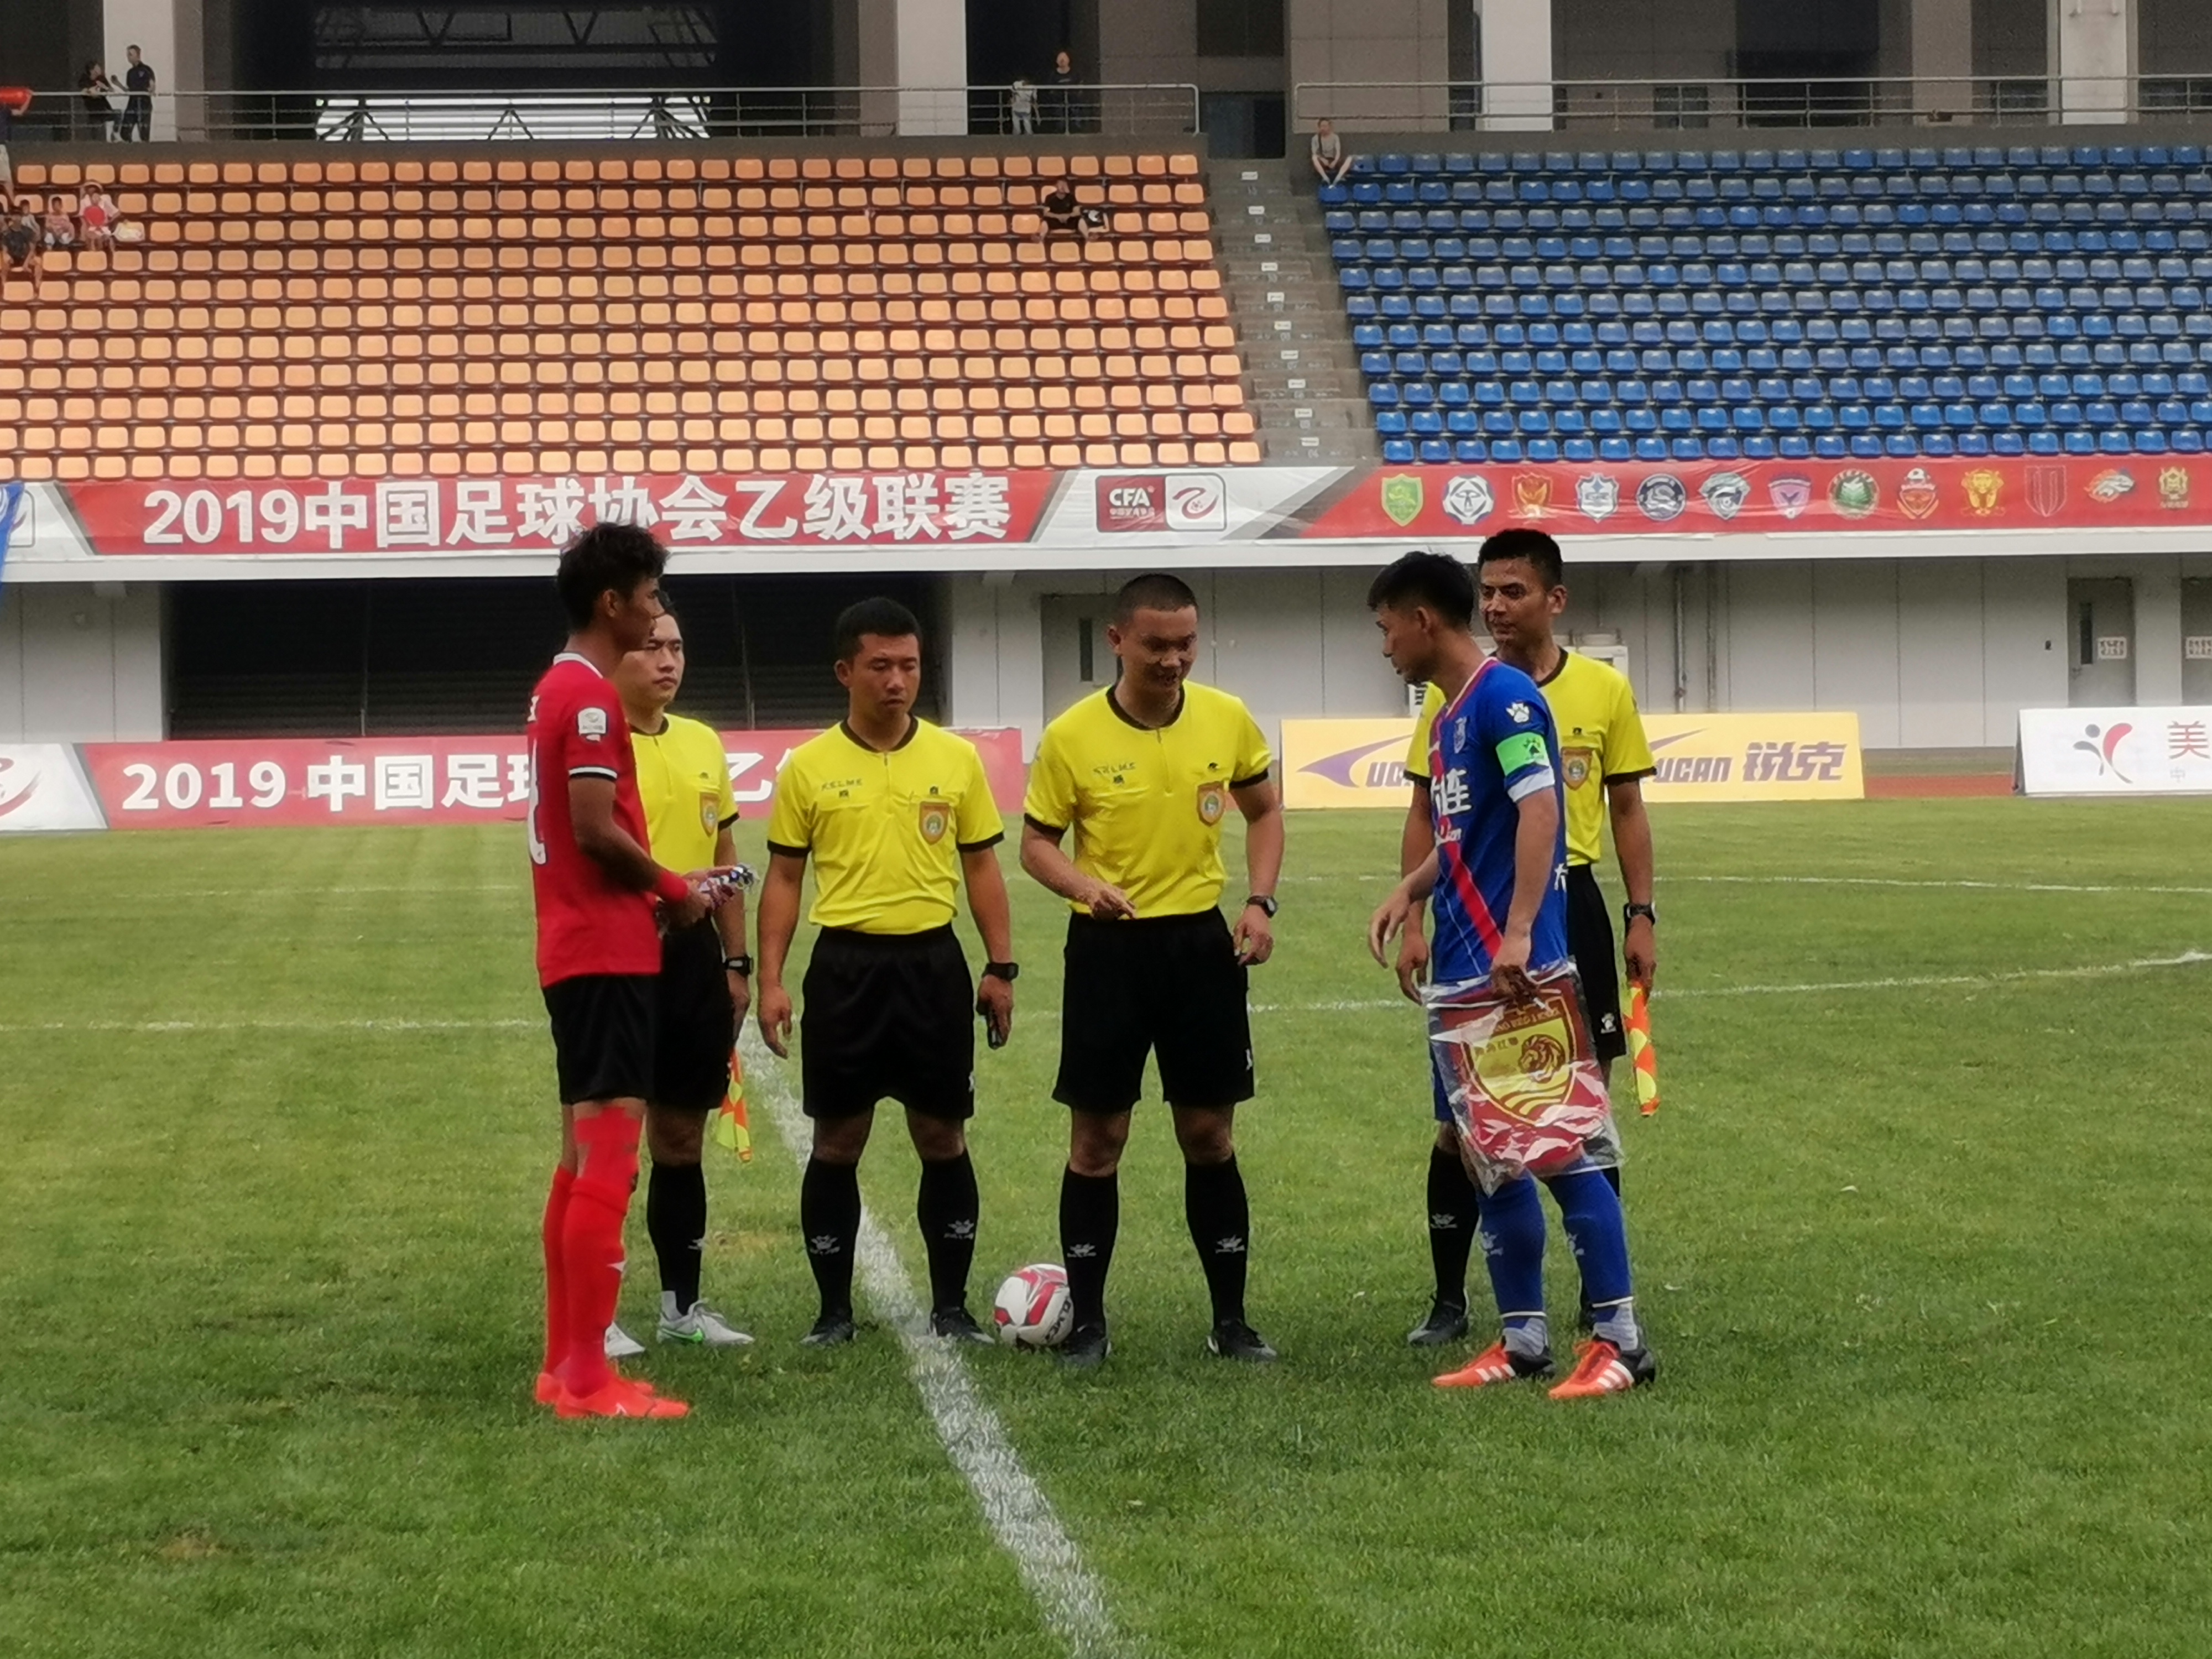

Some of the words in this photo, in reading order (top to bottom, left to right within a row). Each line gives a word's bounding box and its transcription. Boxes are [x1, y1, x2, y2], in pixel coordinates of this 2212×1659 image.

[143, 473, 1010, 549] 2019中国足球协会乙级联赛
[1109, 487, 1150, 507] CFA
[2167, 721, 2211, 760] 美
[122, 762, 286, 810] 2019
